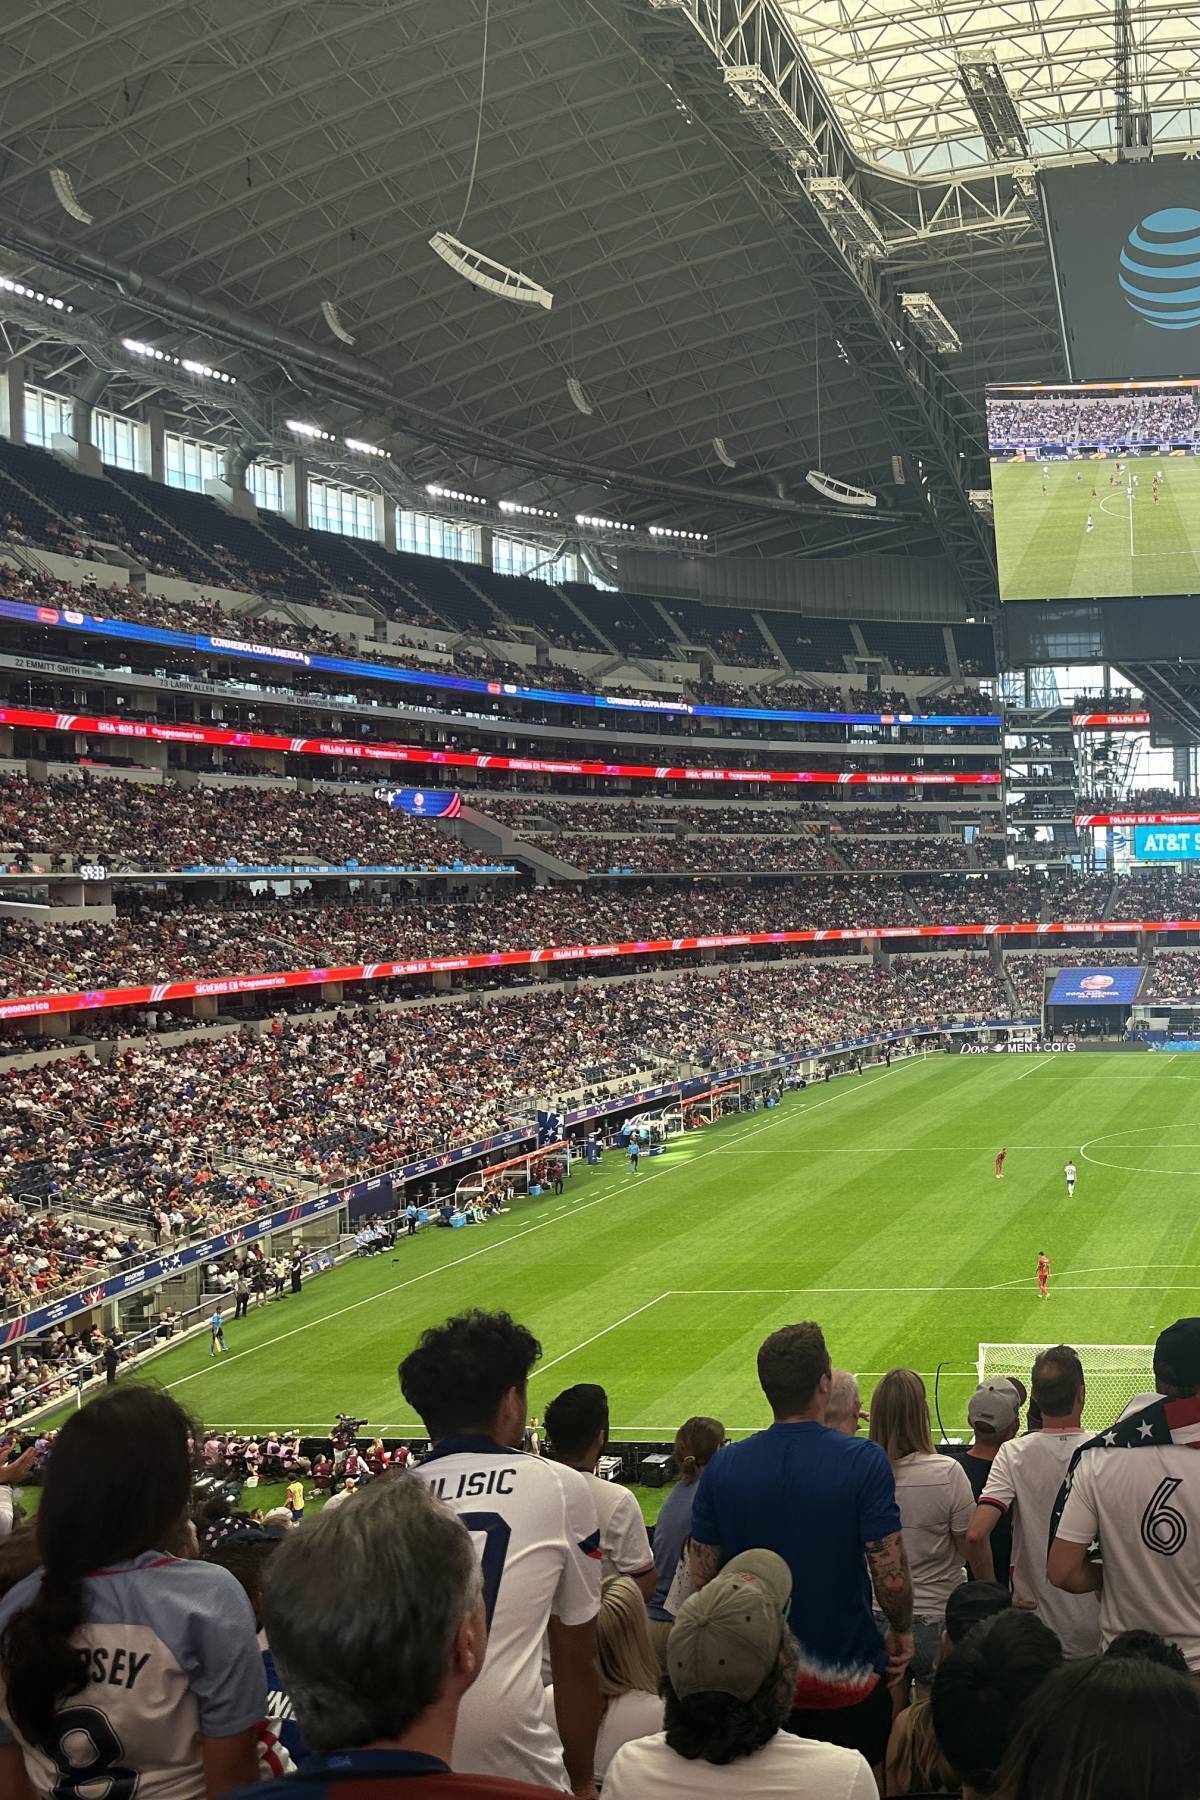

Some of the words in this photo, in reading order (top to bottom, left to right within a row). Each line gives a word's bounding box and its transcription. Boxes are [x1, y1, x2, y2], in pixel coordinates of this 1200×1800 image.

[15, 658, 24, 667] 22
[26, 659, 55, 672] EMMITT
[57, 662, 80, 675] SMITH
[160, 678, 169, 688] 73
[170, 679, 193, 692] LARRY
[193, 682, 215, 693] ALLEN
[1109, 815, 1136, 825] FOLLOW
[1143, 834, 1190, 852] AT&T
[960, 1042, 989, 1055] Dove
[1007, 1043, 1033, 1053] MEN
[1043, 1042, 1076, 1053] care
[430, 1468, 516, 1501] LISIC
[1140, 1476, 1187, 1556] 6
